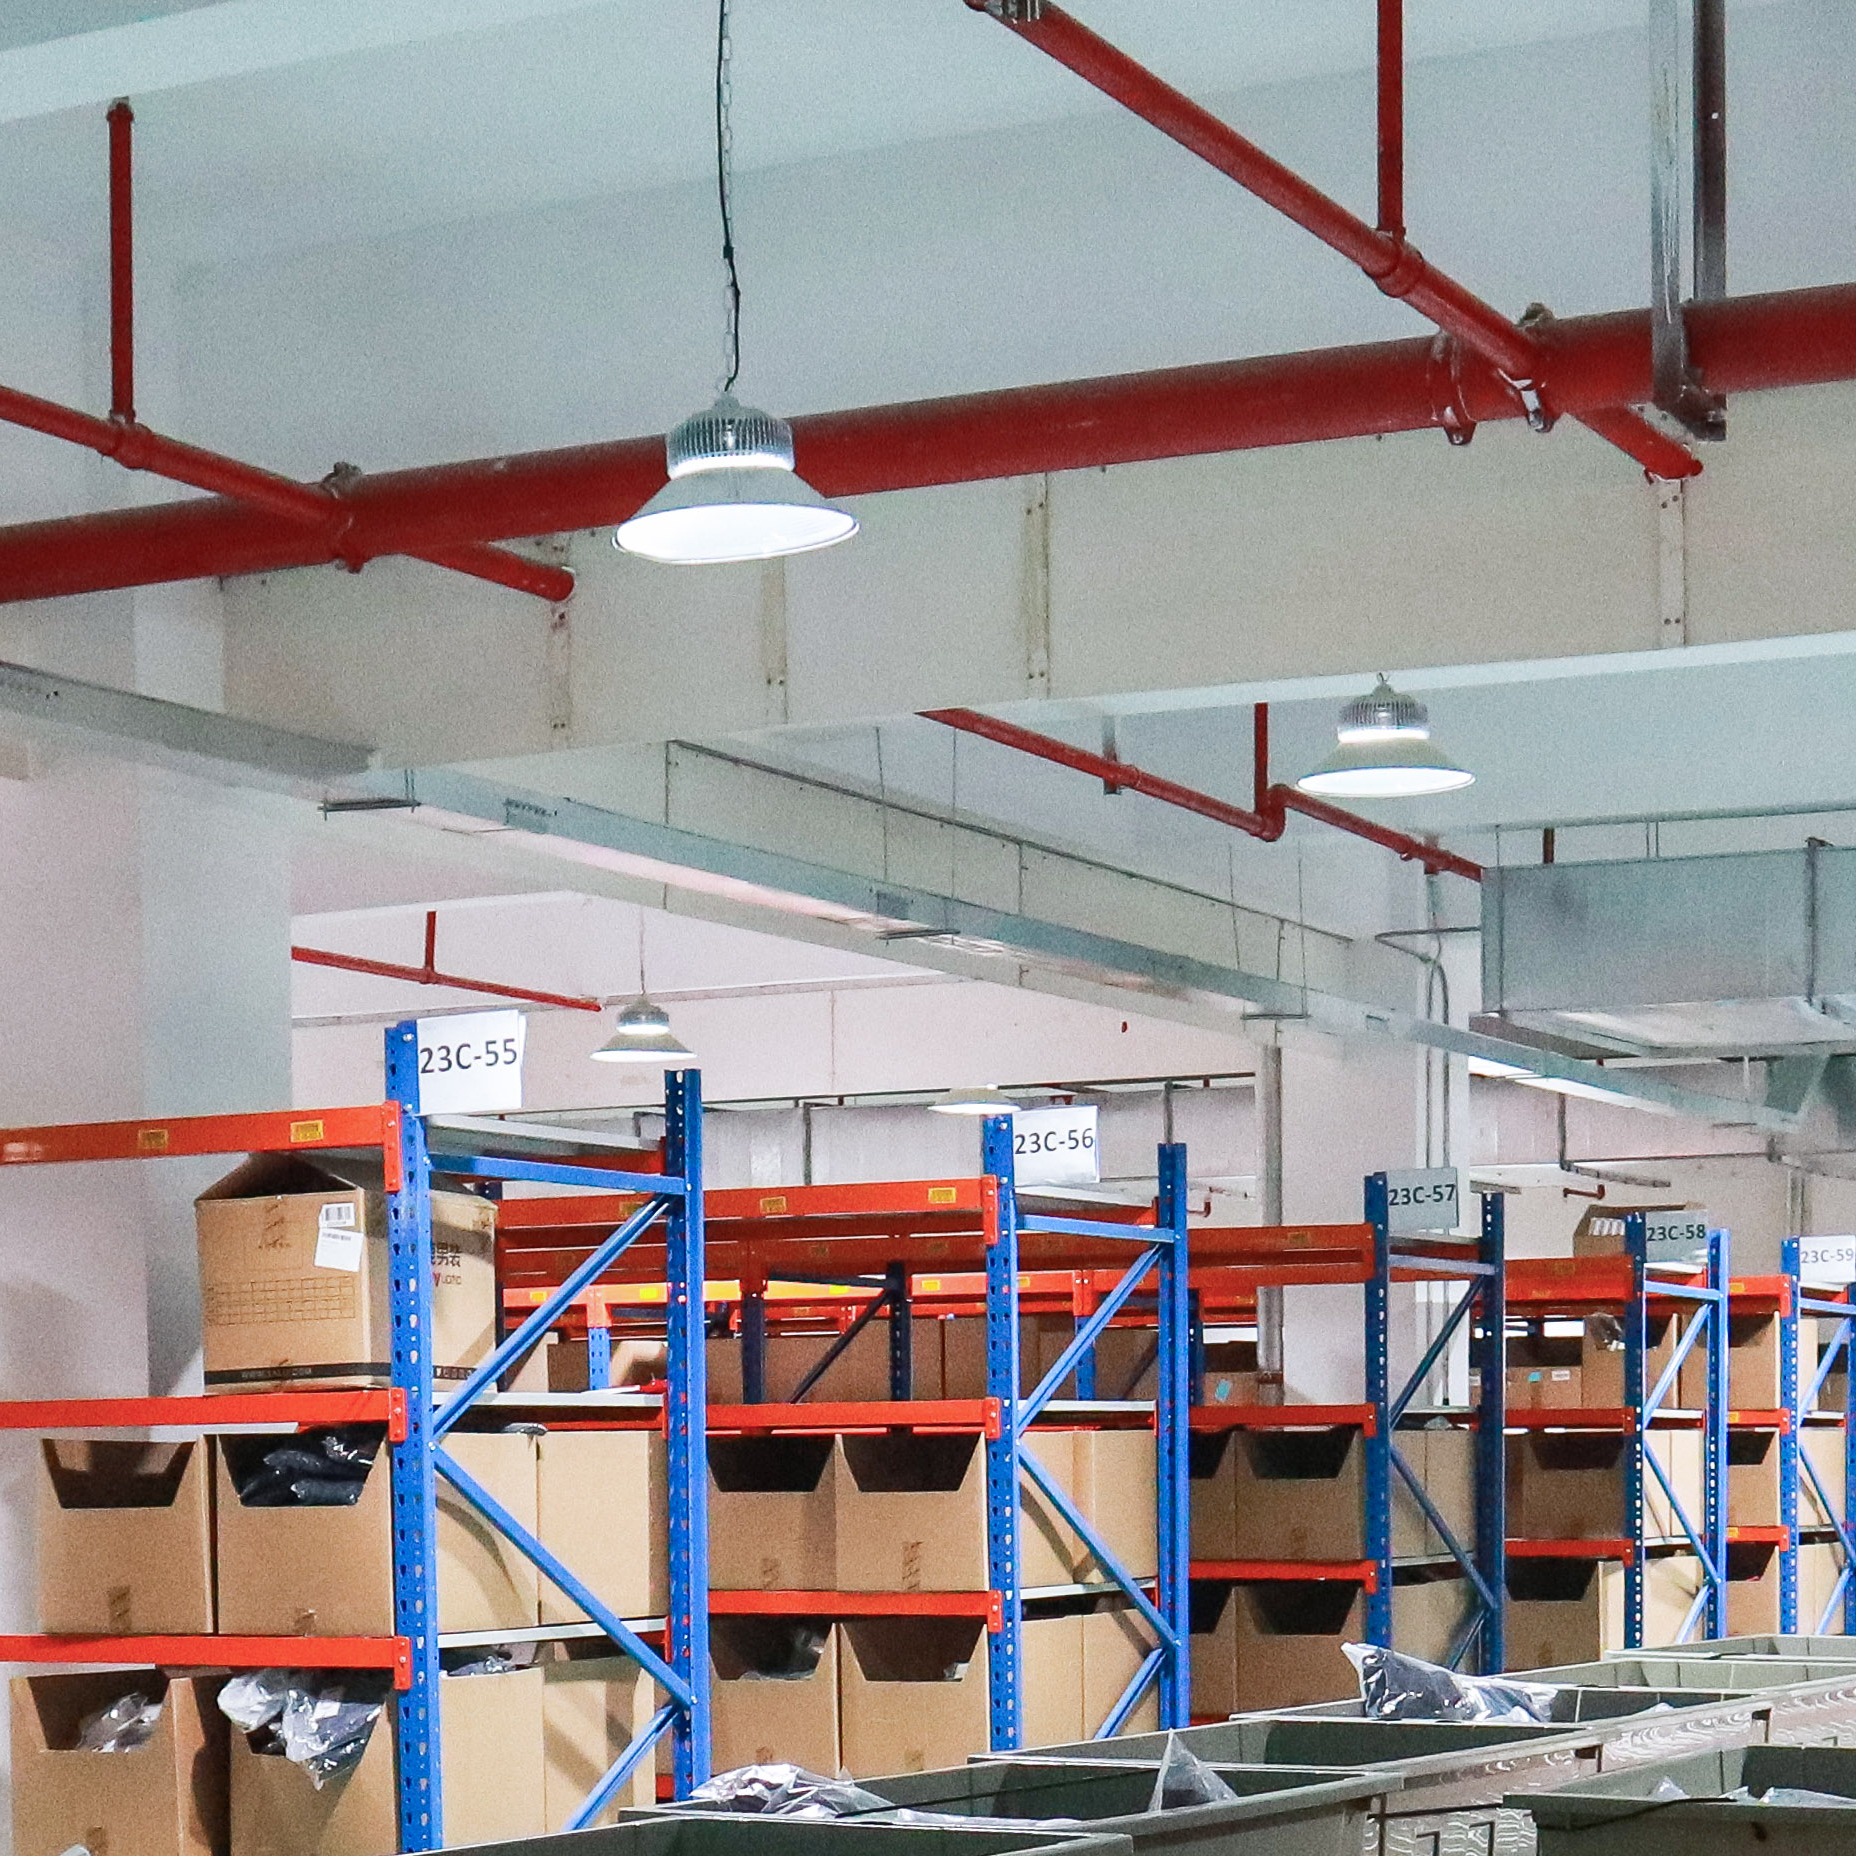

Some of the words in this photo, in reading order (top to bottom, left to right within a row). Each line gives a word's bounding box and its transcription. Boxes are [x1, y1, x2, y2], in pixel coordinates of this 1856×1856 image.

[418, 1037, 519, 1075] 23C-55
[1014, 1126, 1095, 1156] 23C-56
[1387, 1182, 1457, 1207] 23C-57
[1646, 1222, 1707, 1243] 23C-58
[1799, 1247, 1855, 1265] 23C-59
